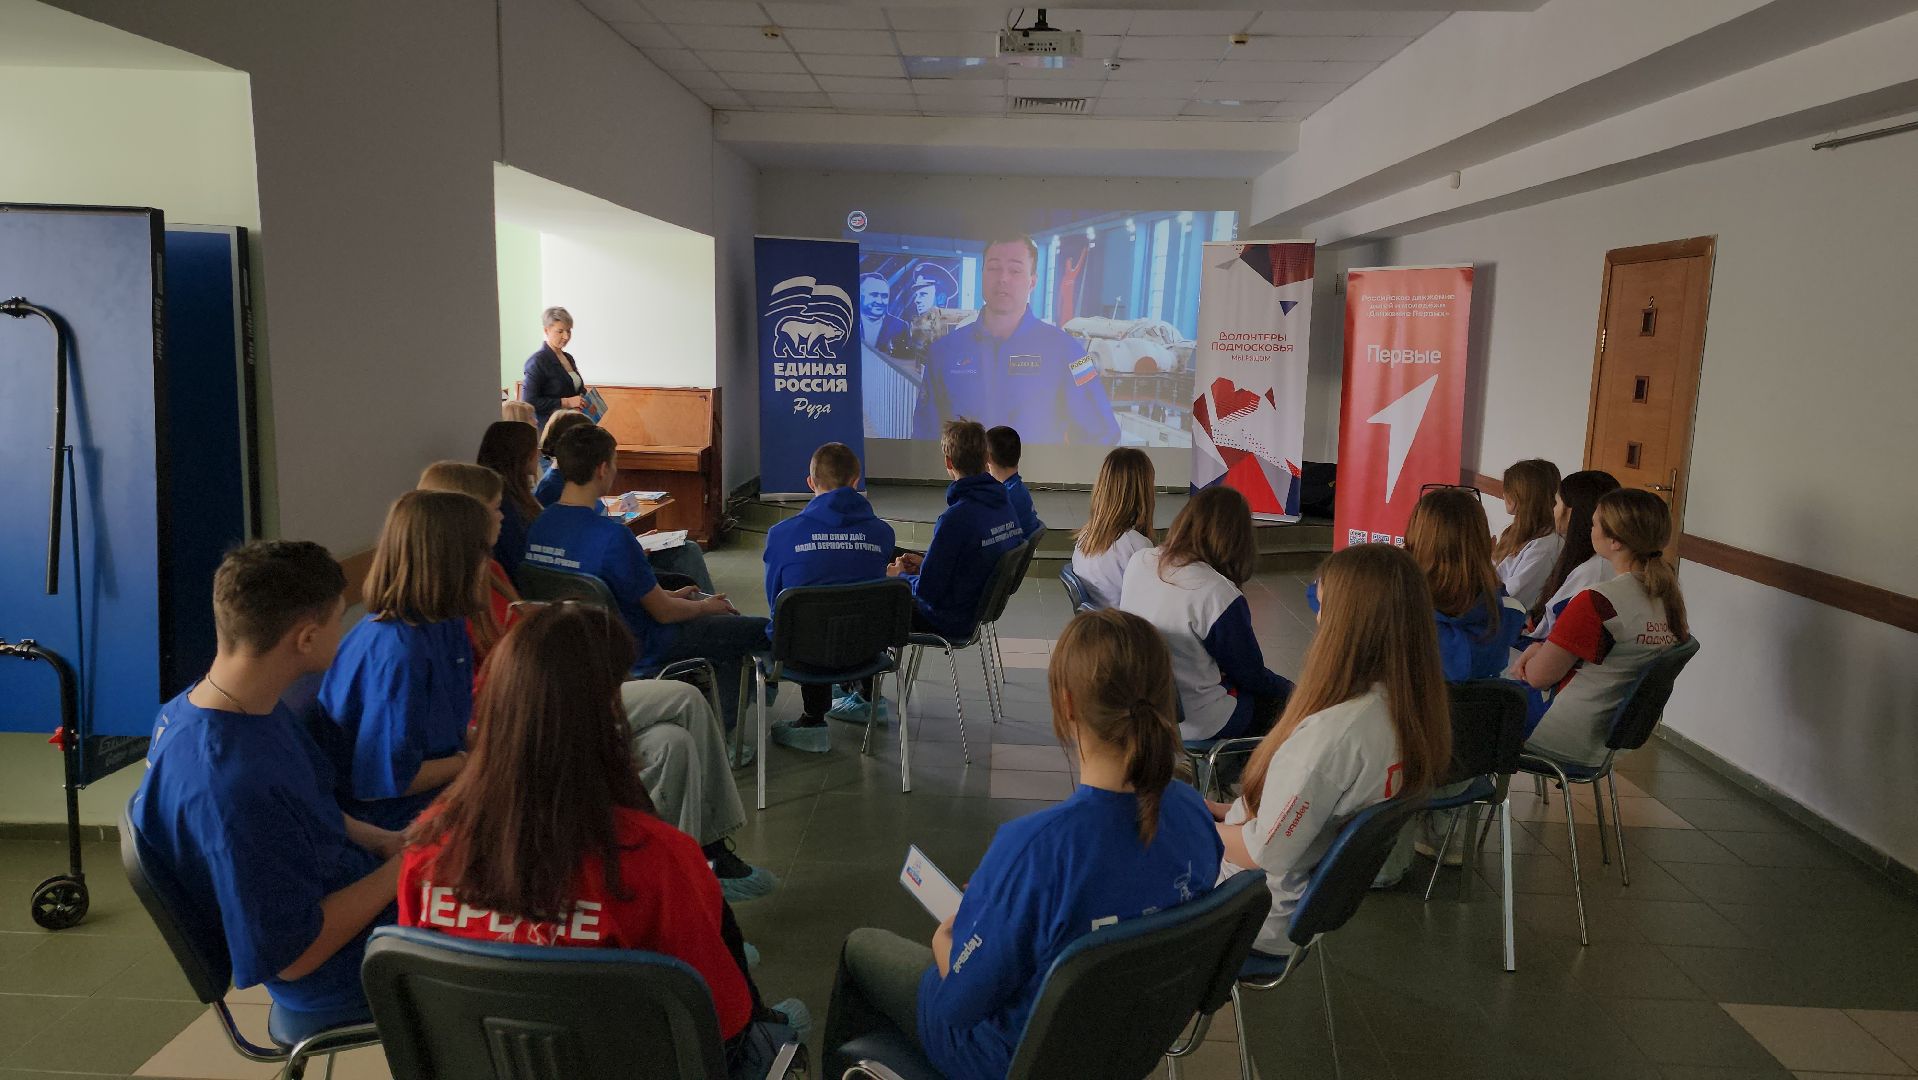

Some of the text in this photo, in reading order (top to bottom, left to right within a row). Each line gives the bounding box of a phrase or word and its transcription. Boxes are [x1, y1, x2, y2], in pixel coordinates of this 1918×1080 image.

[1367, 344, 1442, 368] Первые
[773, 362, 847, 376] ЕДИНАЯ
[774, 378, 848, 393] РОССИЯ
[793, 397, 832, 420] Руза
